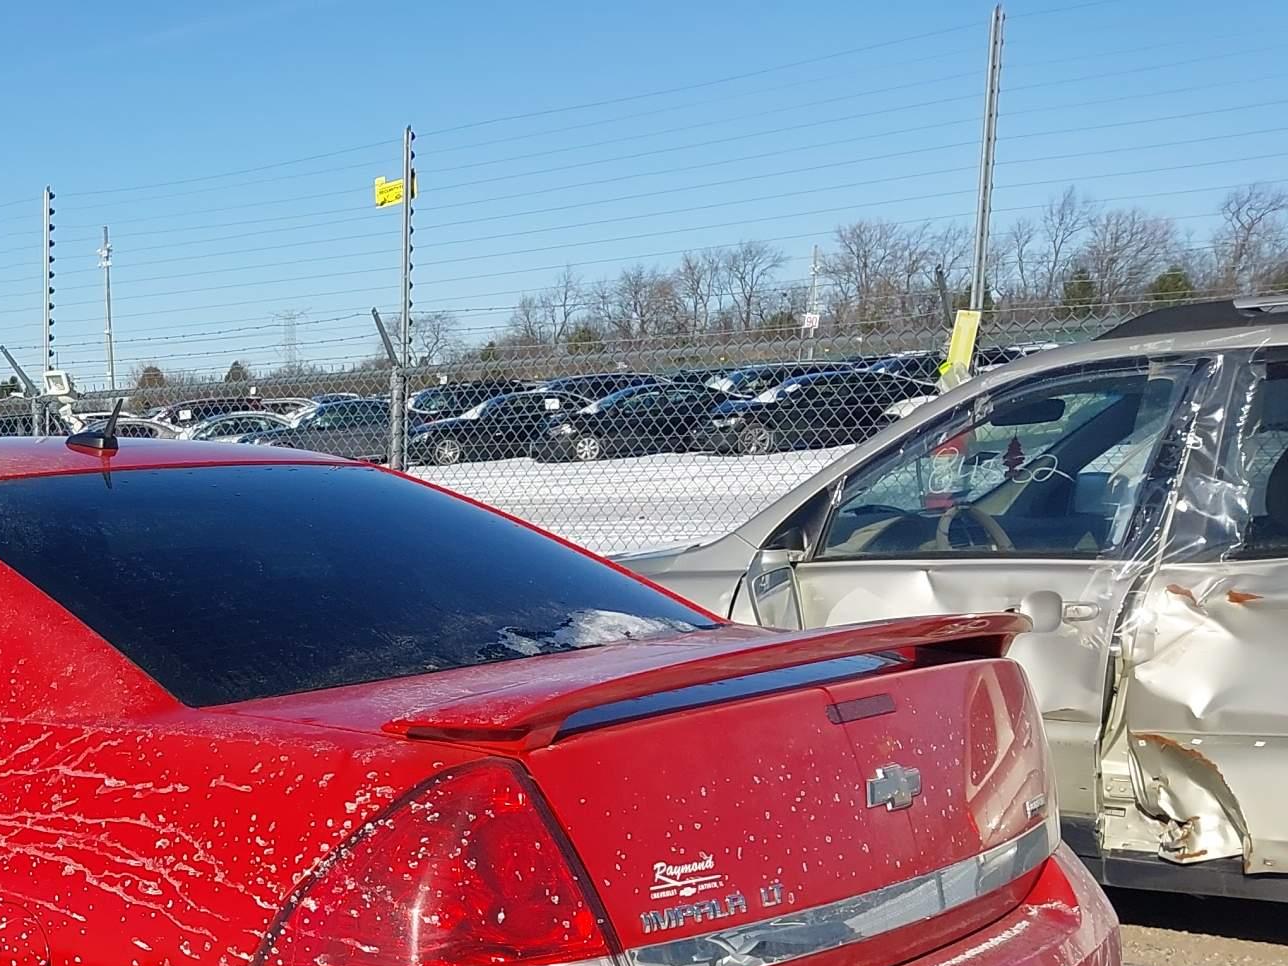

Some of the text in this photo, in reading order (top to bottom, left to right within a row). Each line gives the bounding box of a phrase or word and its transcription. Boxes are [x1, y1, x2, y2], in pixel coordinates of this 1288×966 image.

[654, 855, 714, 882] Raymond
[640, 884, 783, 933] IMPALA LT
